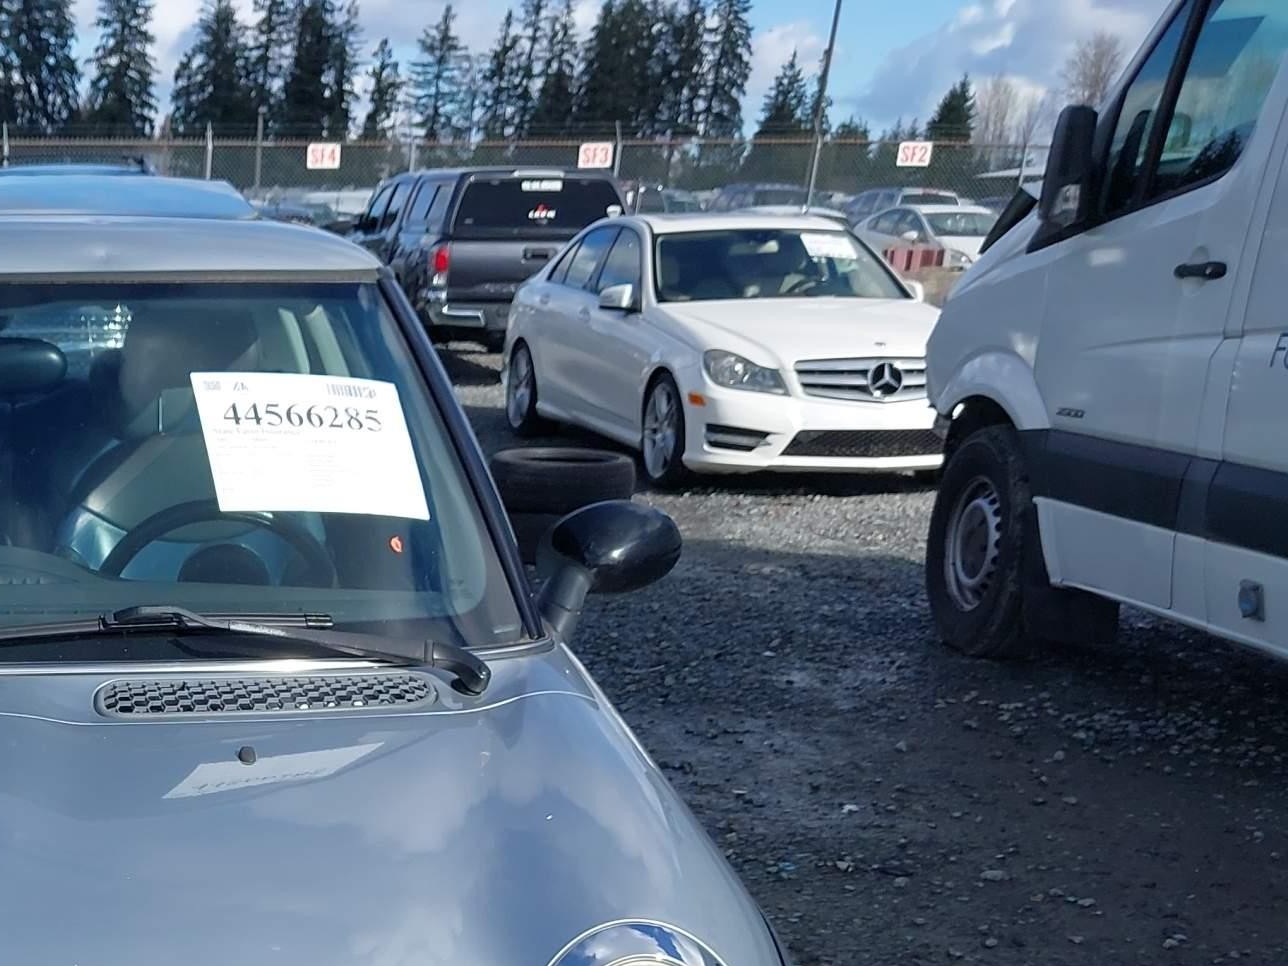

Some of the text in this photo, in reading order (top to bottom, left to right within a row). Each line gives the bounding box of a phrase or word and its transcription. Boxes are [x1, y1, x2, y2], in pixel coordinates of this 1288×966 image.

[311, 148, 337, 166] SF4
[583, 147, 609, 164] SF3
[901, 145, 928, 163] SF2
[223, 402, 383, 433] 44566285
